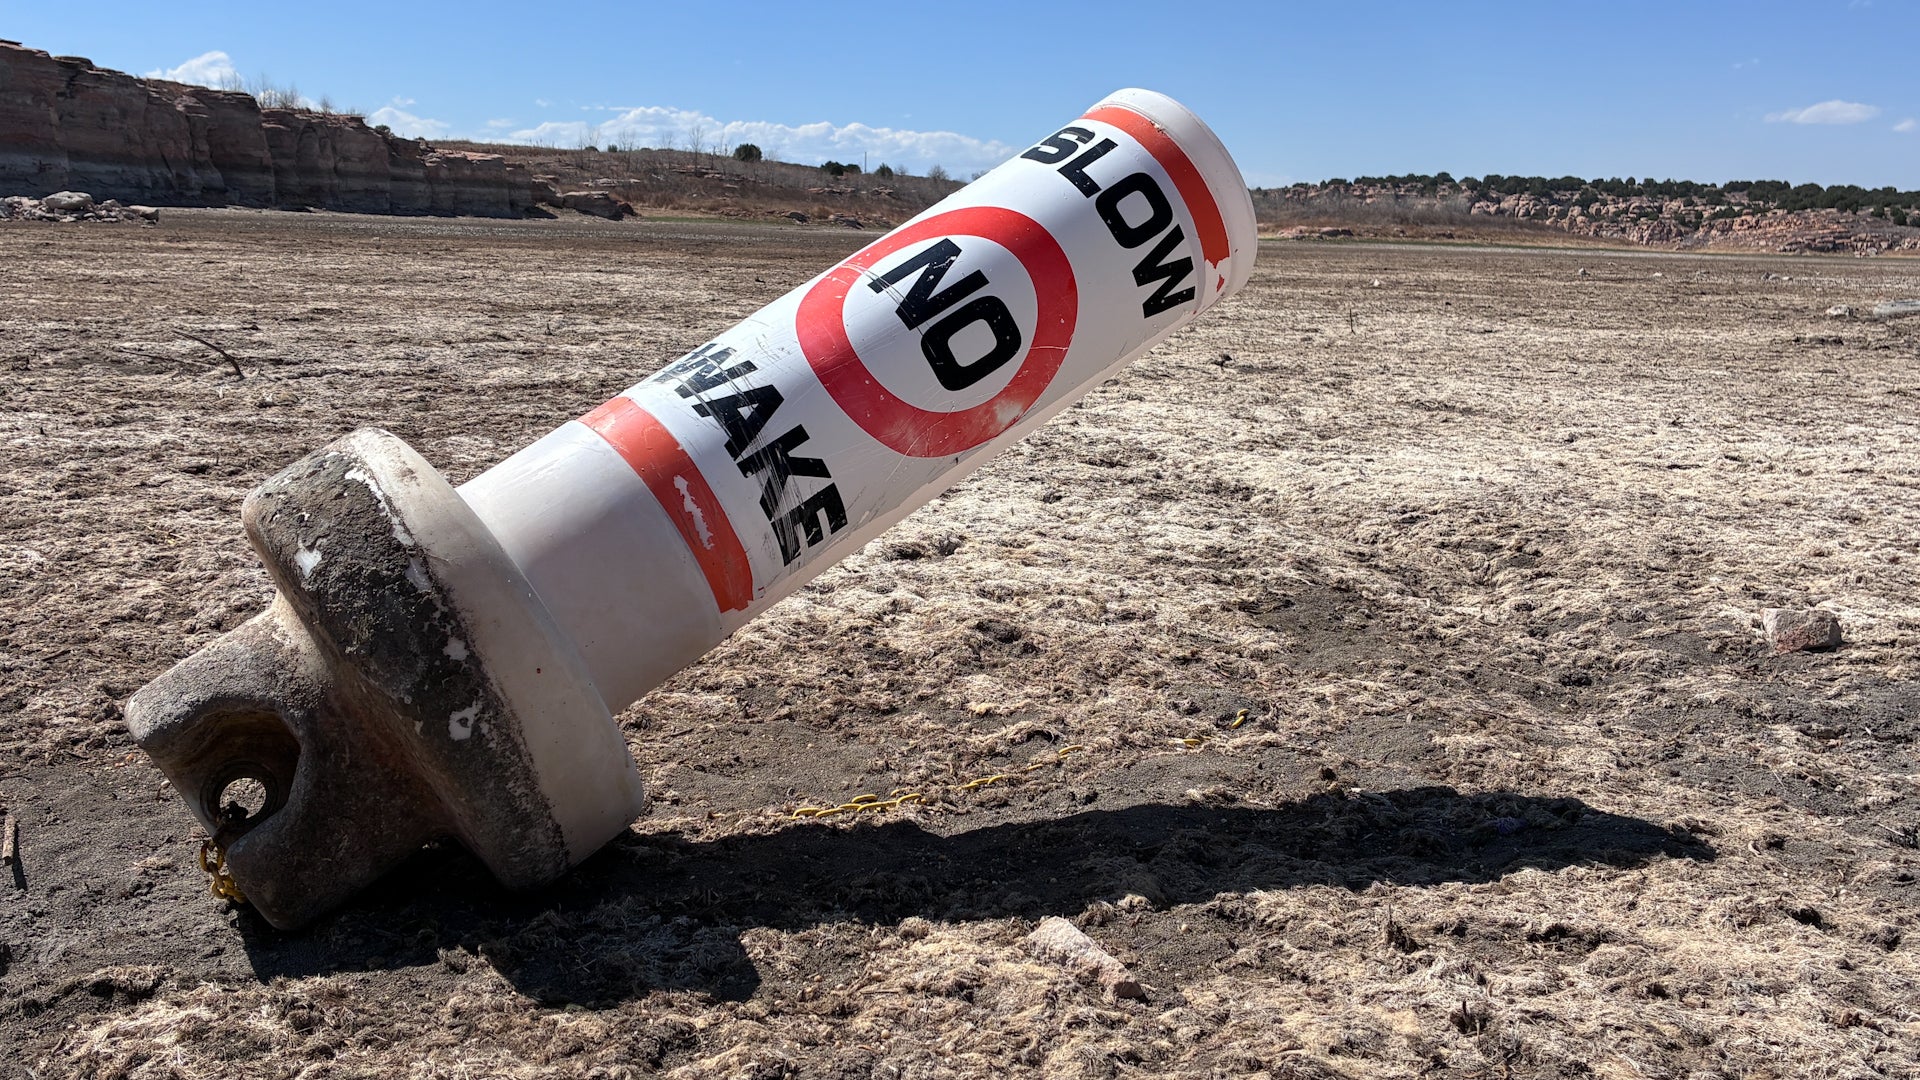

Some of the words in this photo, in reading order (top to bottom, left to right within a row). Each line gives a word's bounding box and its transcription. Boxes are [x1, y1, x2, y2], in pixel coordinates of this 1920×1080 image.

[867, 237, 1022, 391] NO
[1020, 126, 1196, 319] SLOW
[651, 342, 848, 567] WAKE
